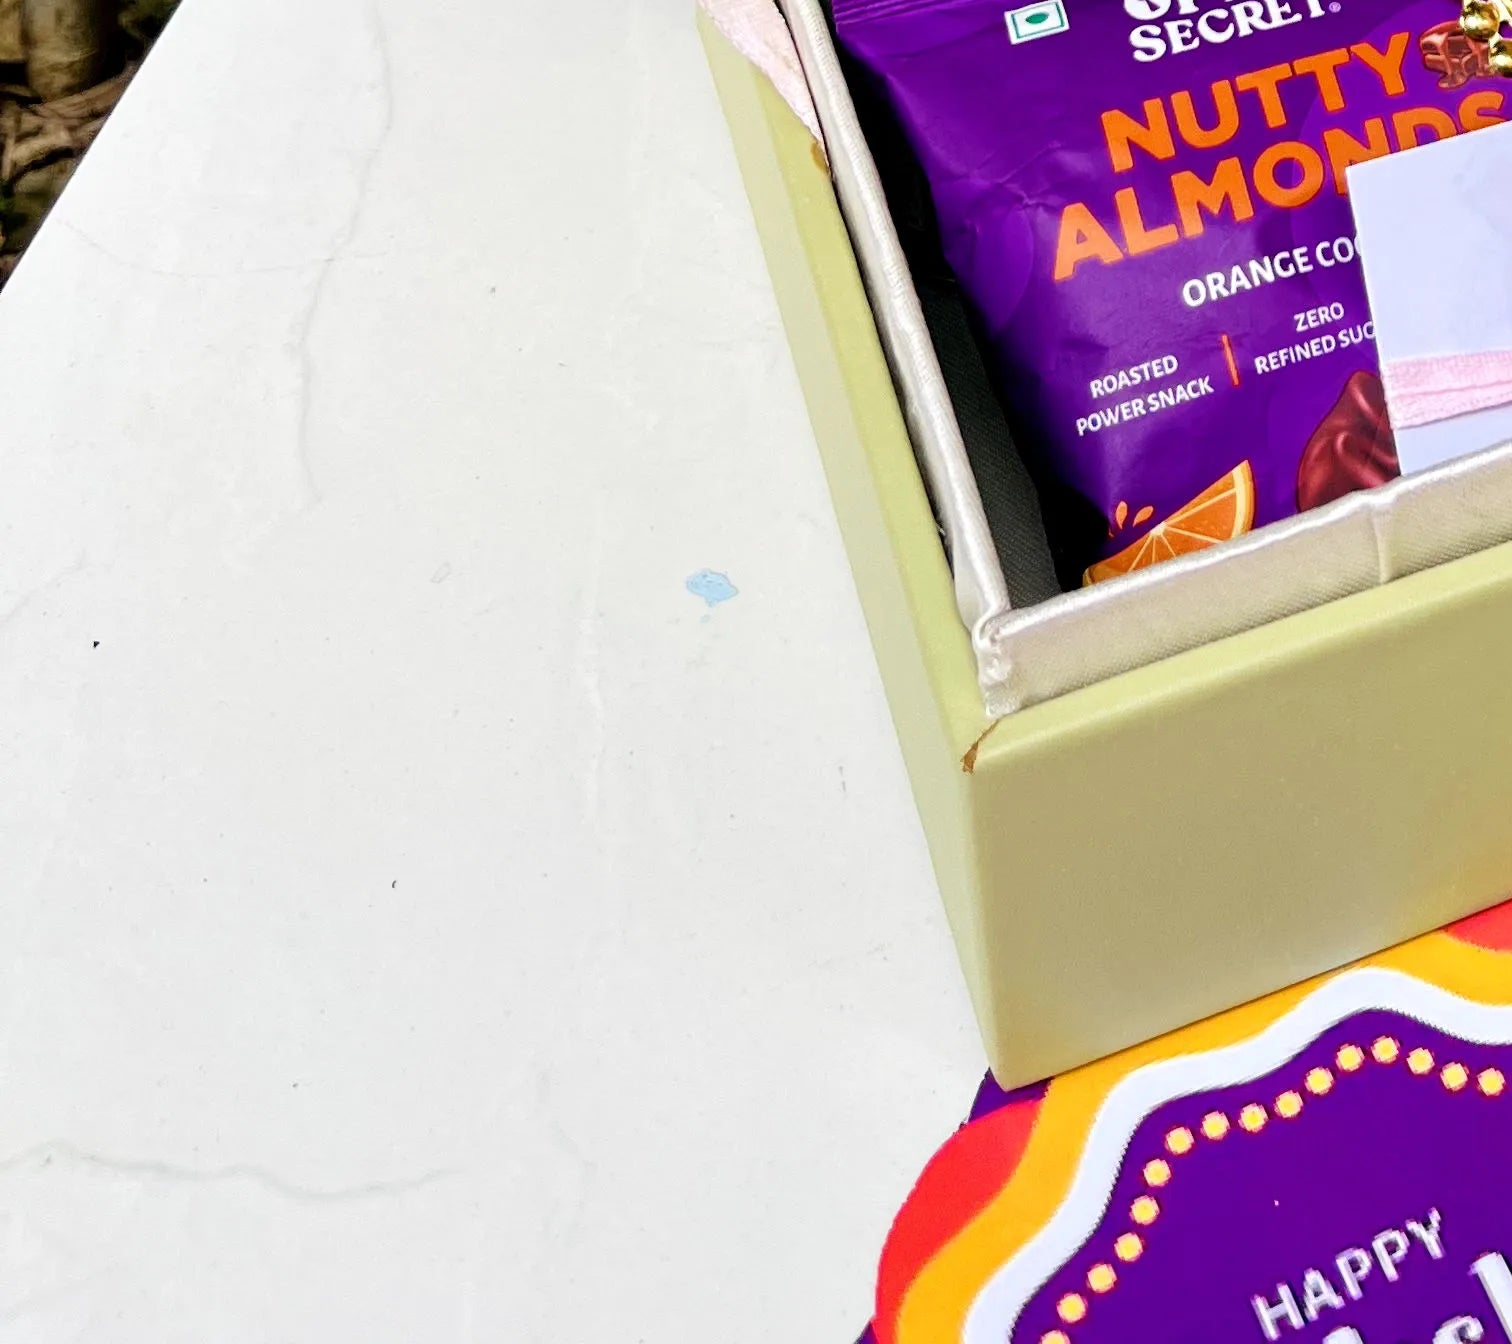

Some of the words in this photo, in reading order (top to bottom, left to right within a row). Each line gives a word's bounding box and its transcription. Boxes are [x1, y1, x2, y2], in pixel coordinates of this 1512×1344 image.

[1099, 31, 1411, 173] NUTTY
[1182, 246, 1314, 308] ORANGE
[1293, 302, 1345, 333] ZERO
[1089, 354, 1179, 399] ROASTED
[1253, 334, 1336, 375] REFINED
[1076, 394, 1147, 437] POWER
[1147, 375, 1214, 417] SNACK
[1250, 1207, 1445, 1341] HAPPY
